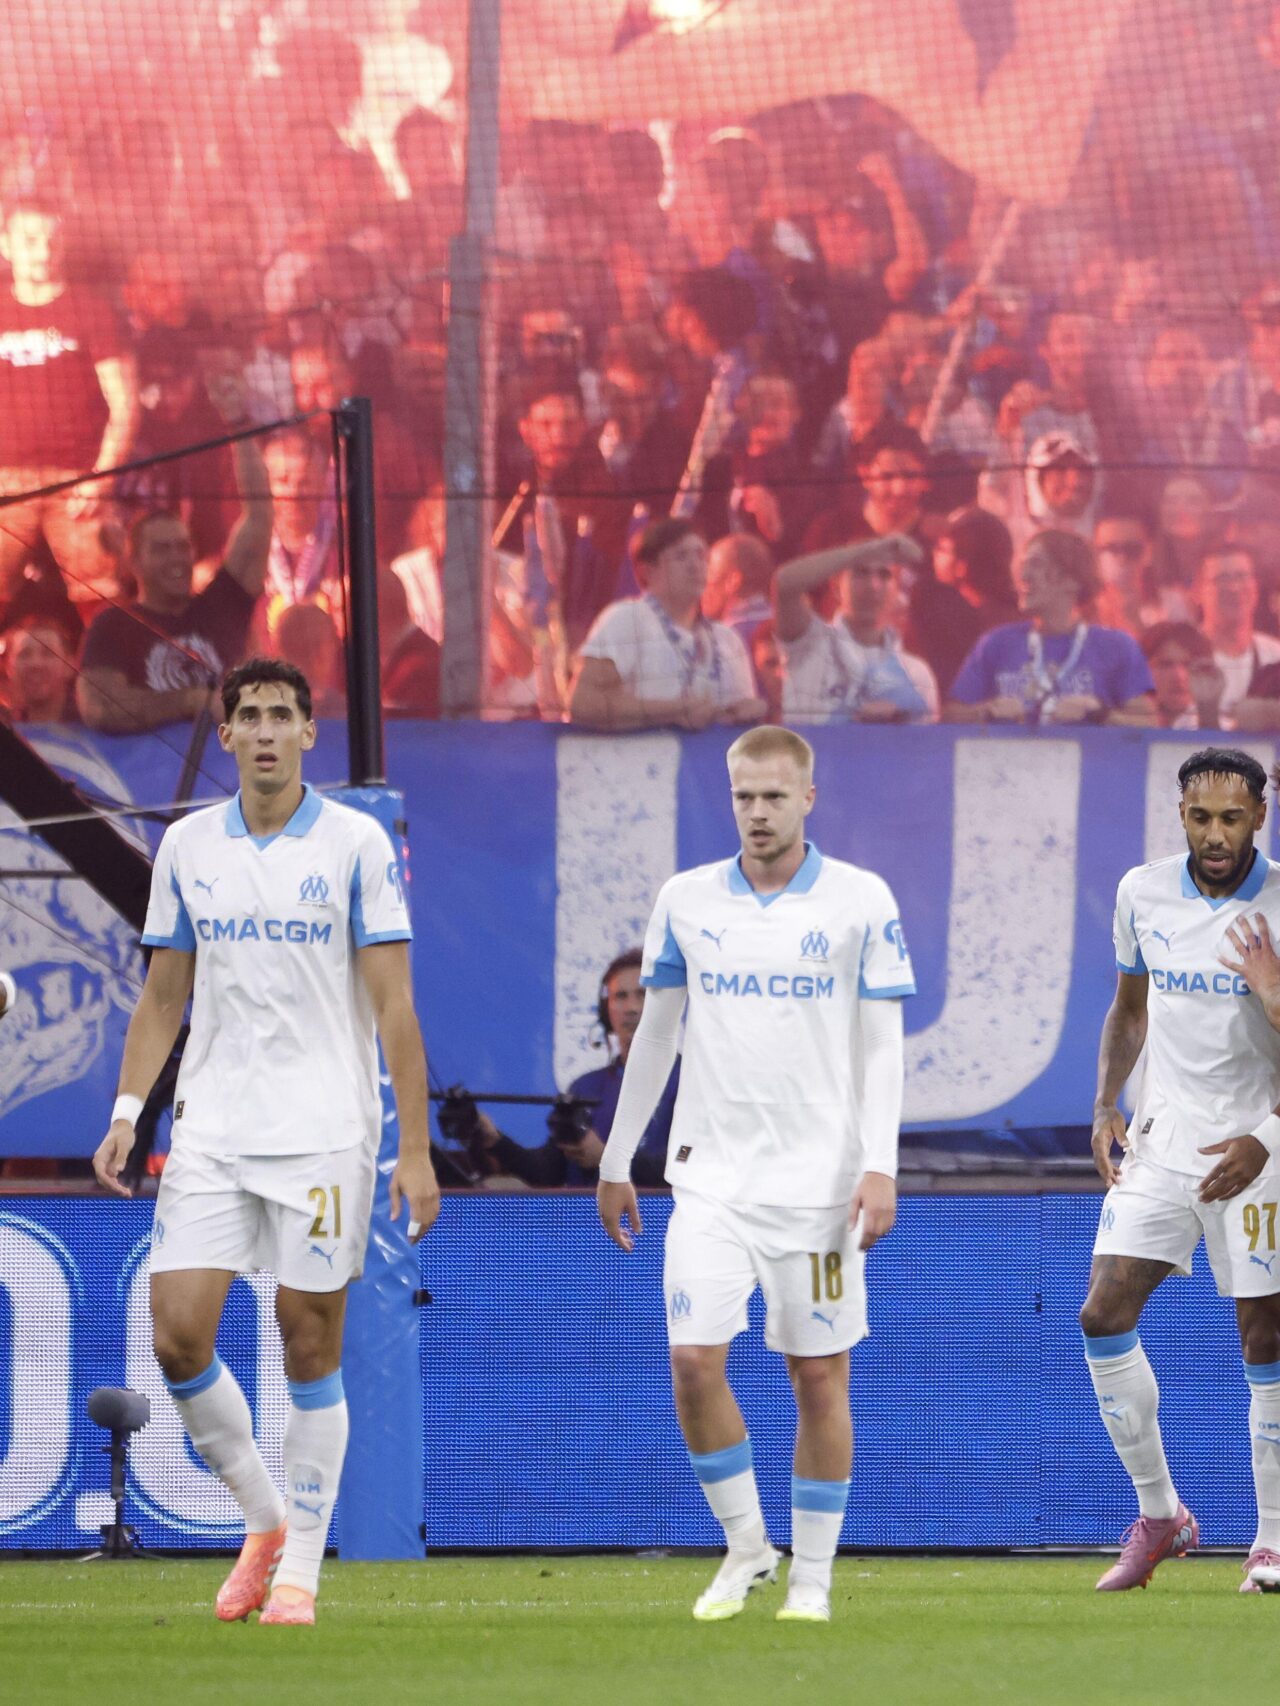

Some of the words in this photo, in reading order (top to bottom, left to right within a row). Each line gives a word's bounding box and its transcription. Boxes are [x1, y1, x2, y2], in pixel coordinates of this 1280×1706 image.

[196, 918, 261, 942] CMA
[263, 919, 333, 945] CGM
[699, 972, 763, 997] CMA
[767, 975, 835, 999] CGM
[1151, 969, 1209, 994] CMA
[1212, 972, 1251, 996] CG
[307, 1185, 342, 1240] 21
[1242, 1201, 1279, 1252] 97
[808, 1250, 845, 1305] 18
[295, 1482, 321, 1494] OM
